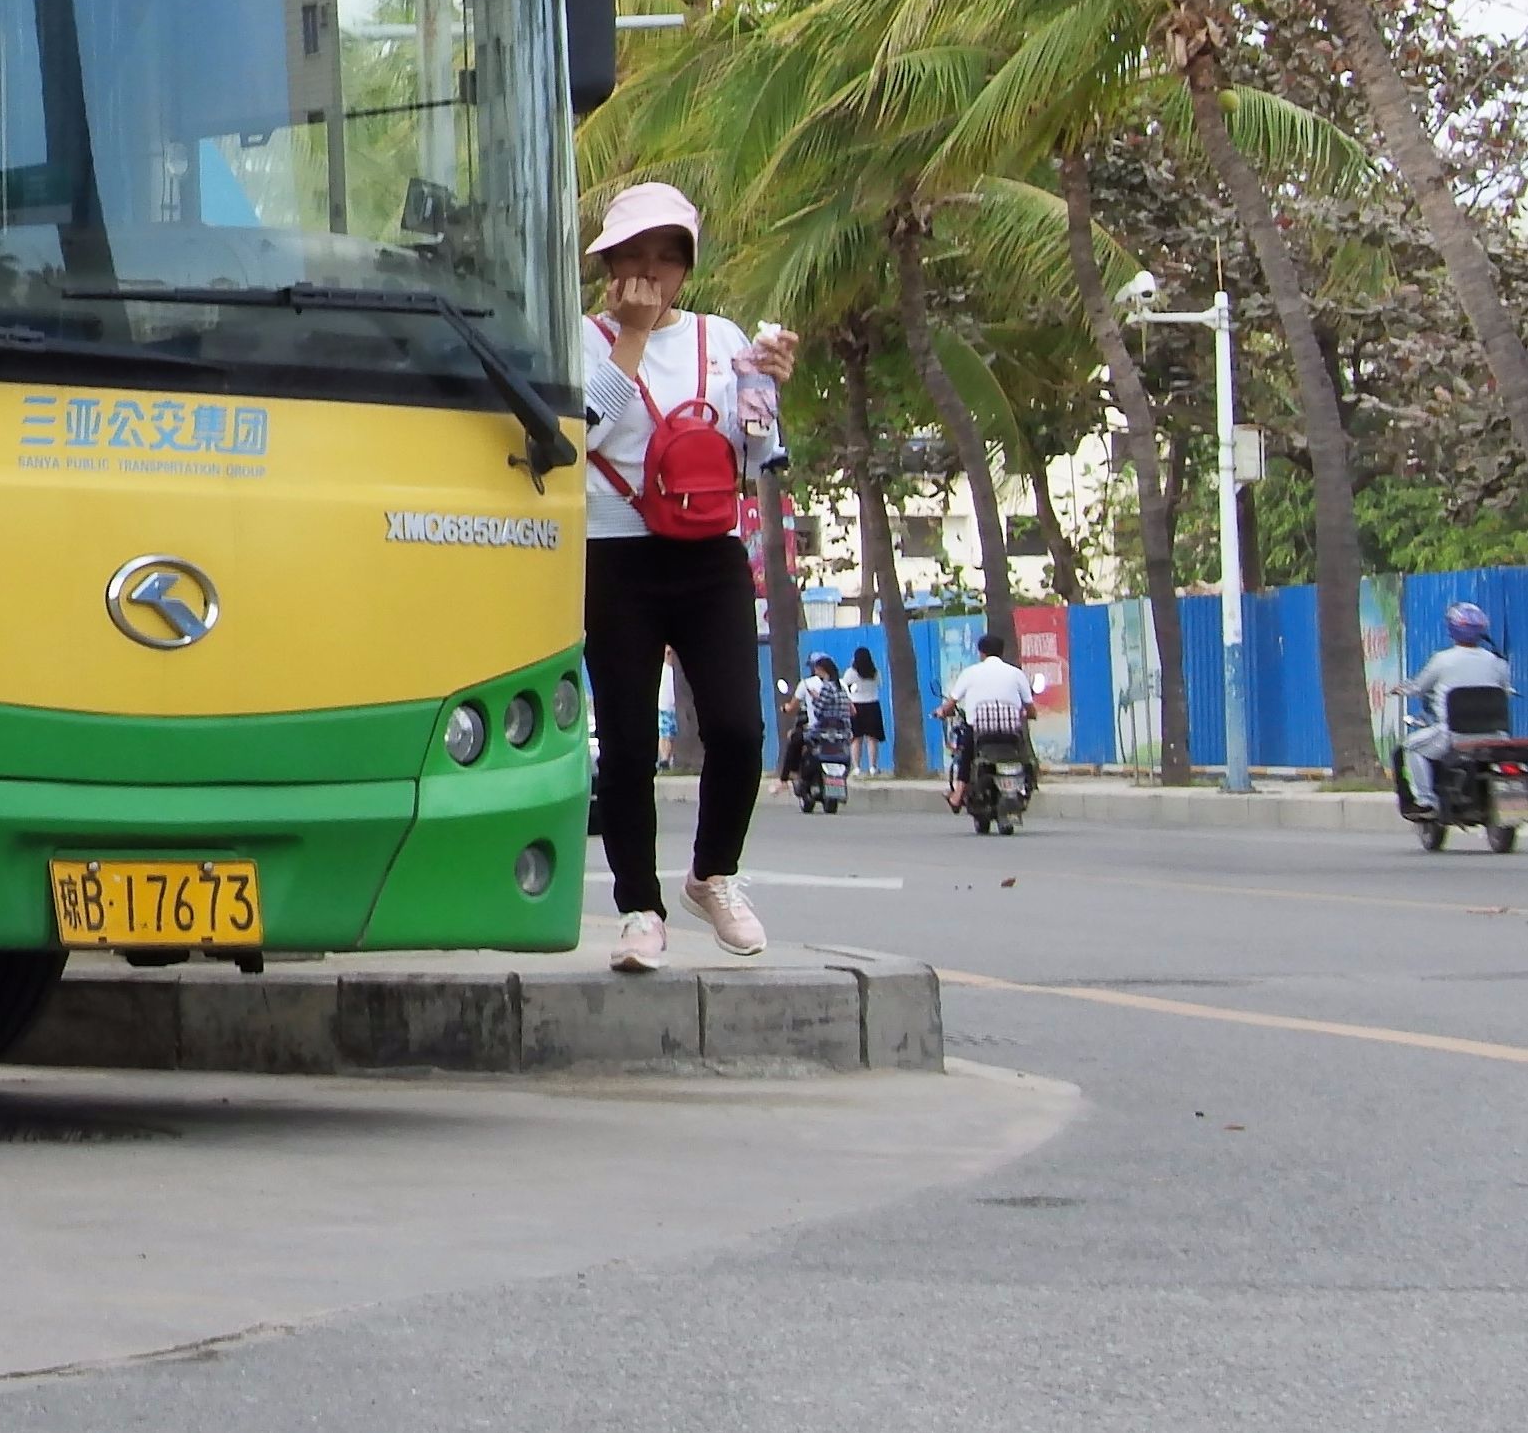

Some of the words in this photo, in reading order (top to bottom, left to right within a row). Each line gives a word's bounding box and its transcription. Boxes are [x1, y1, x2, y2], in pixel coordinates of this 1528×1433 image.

[20, 396, 268, 455] 三亚公交集团
[18, 455, 60, 470] SANYA
[66, 456, 109, 472] PUBLIC
[226, 461, 267, 478] GROUP
